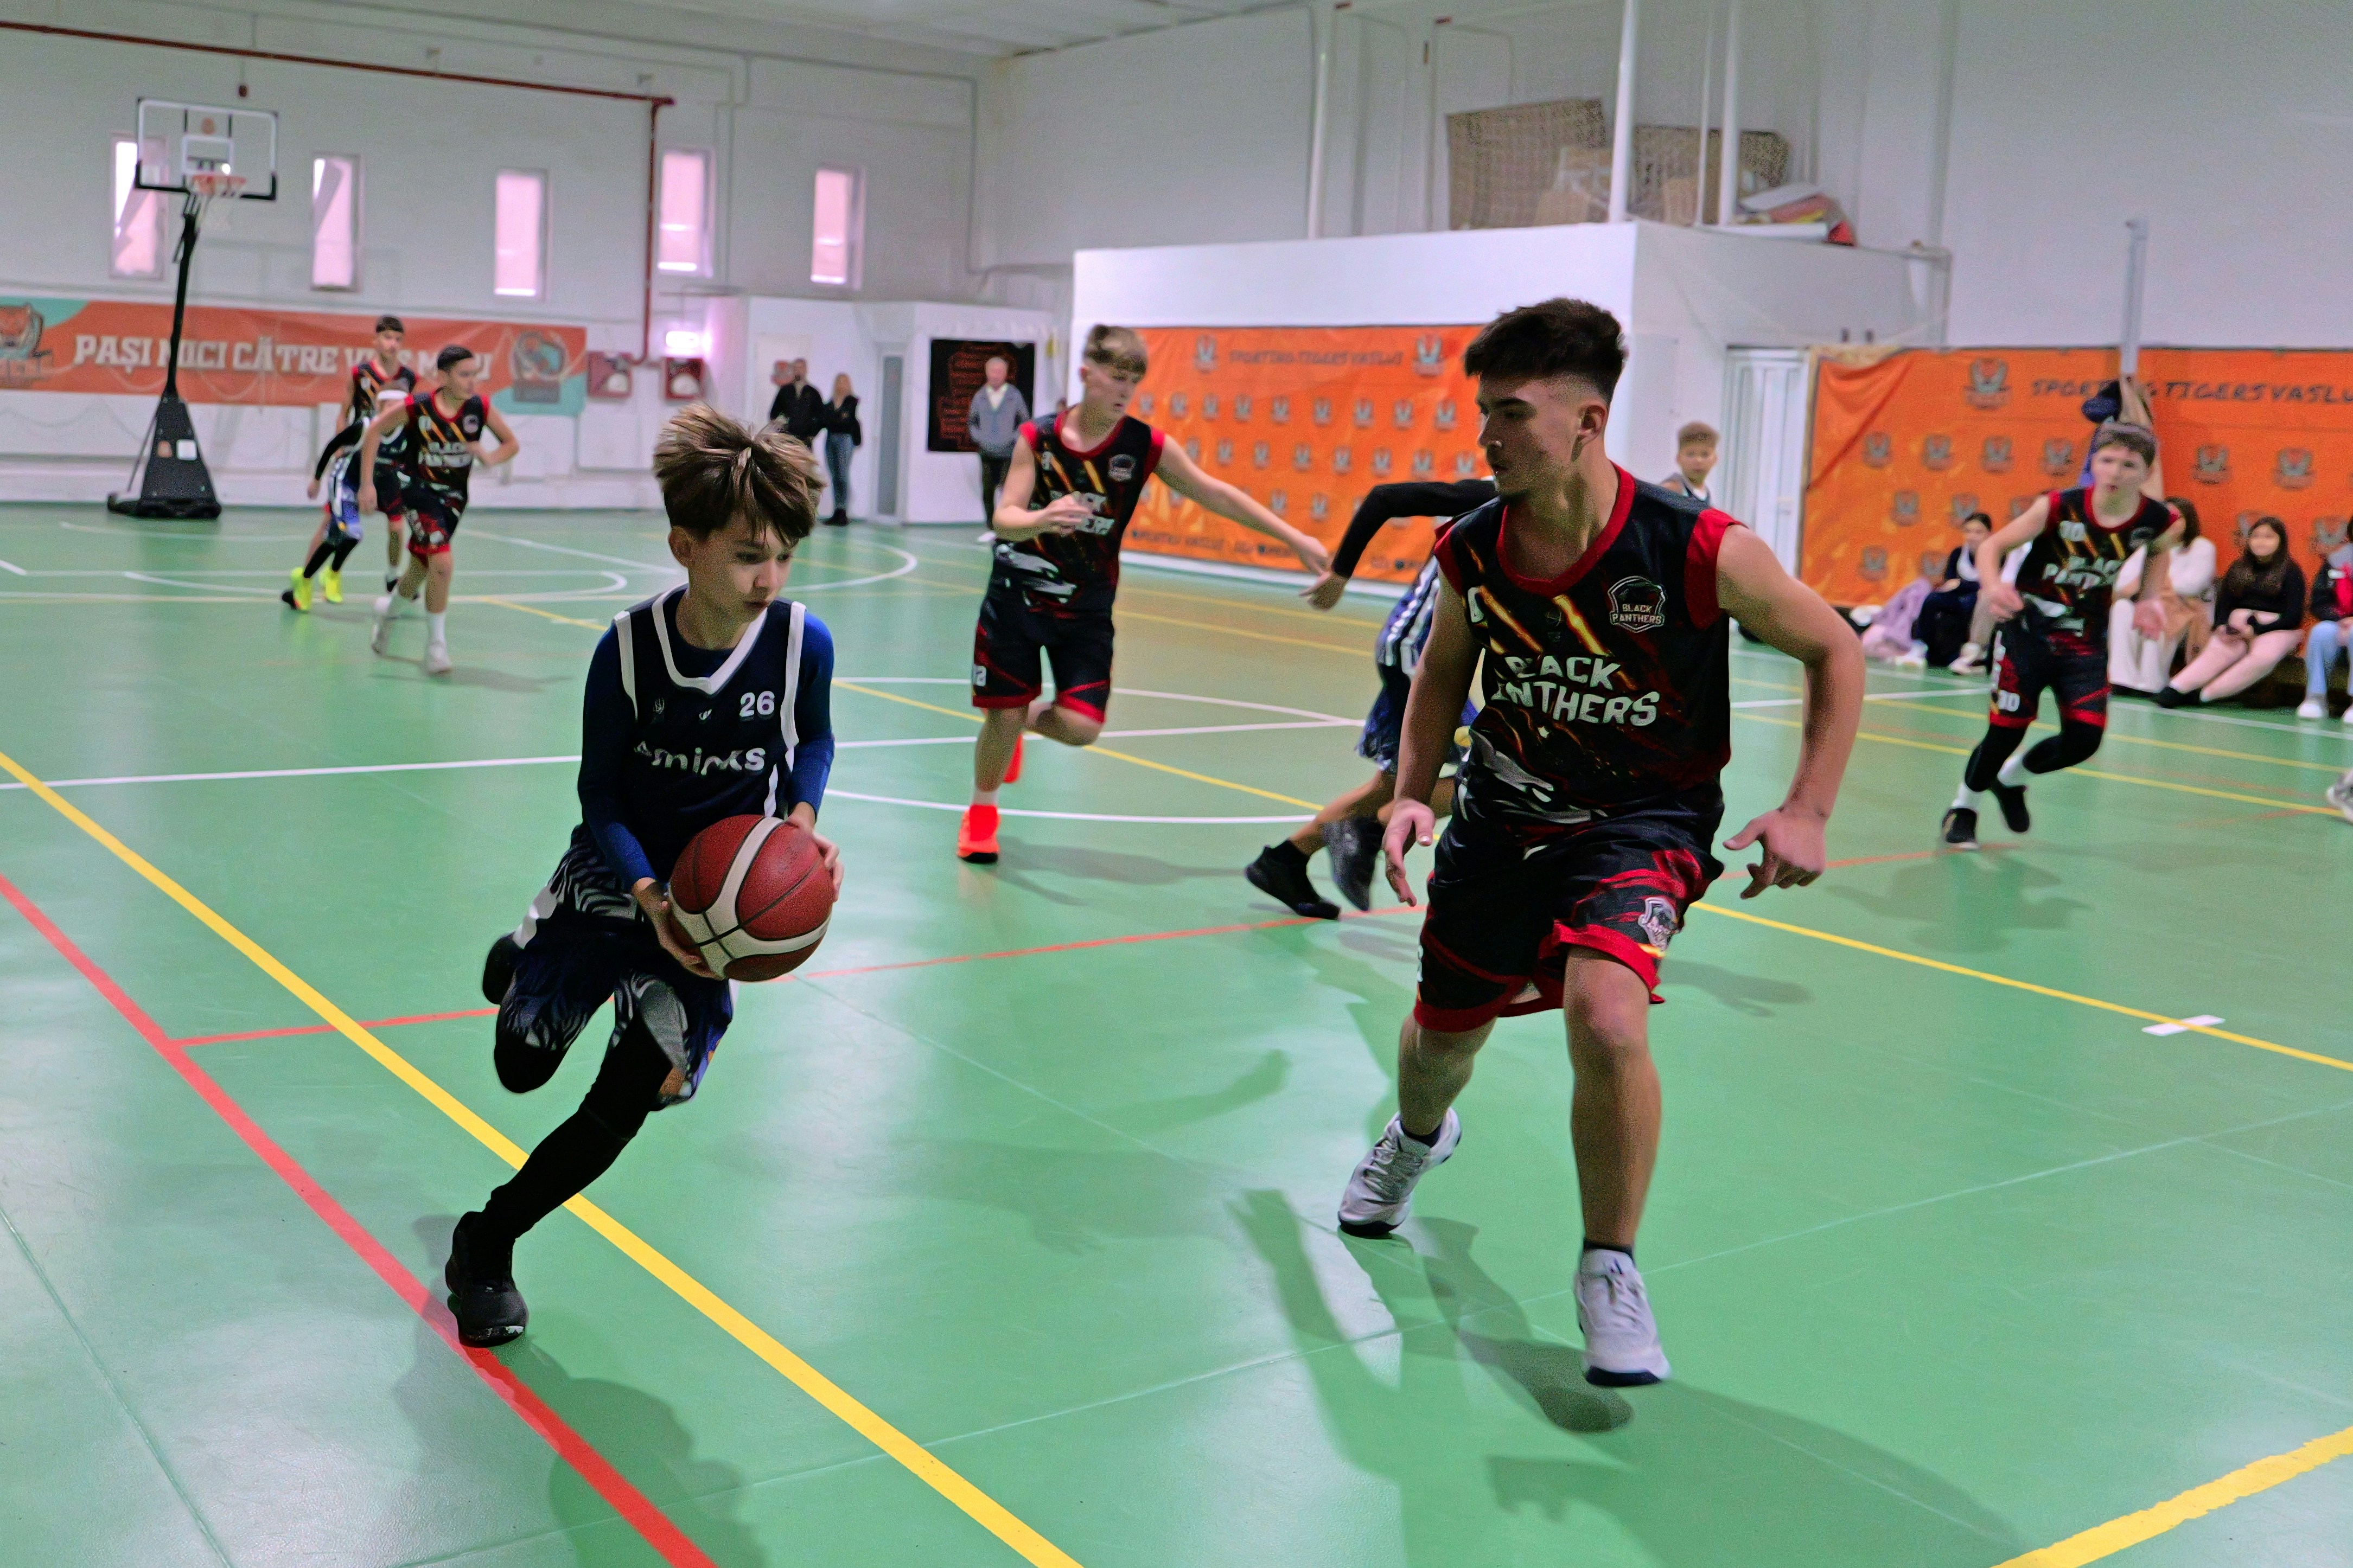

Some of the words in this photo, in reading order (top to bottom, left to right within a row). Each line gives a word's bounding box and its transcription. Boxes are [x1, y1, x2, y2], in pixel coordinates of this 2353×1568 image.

[2166, 381, 2266, 400] TIGERS
[1622, 603, 1652, 612] BLACK
[1612, 613, 1662, 624] PANTHERS
[739, 690, 775, 717] 26
